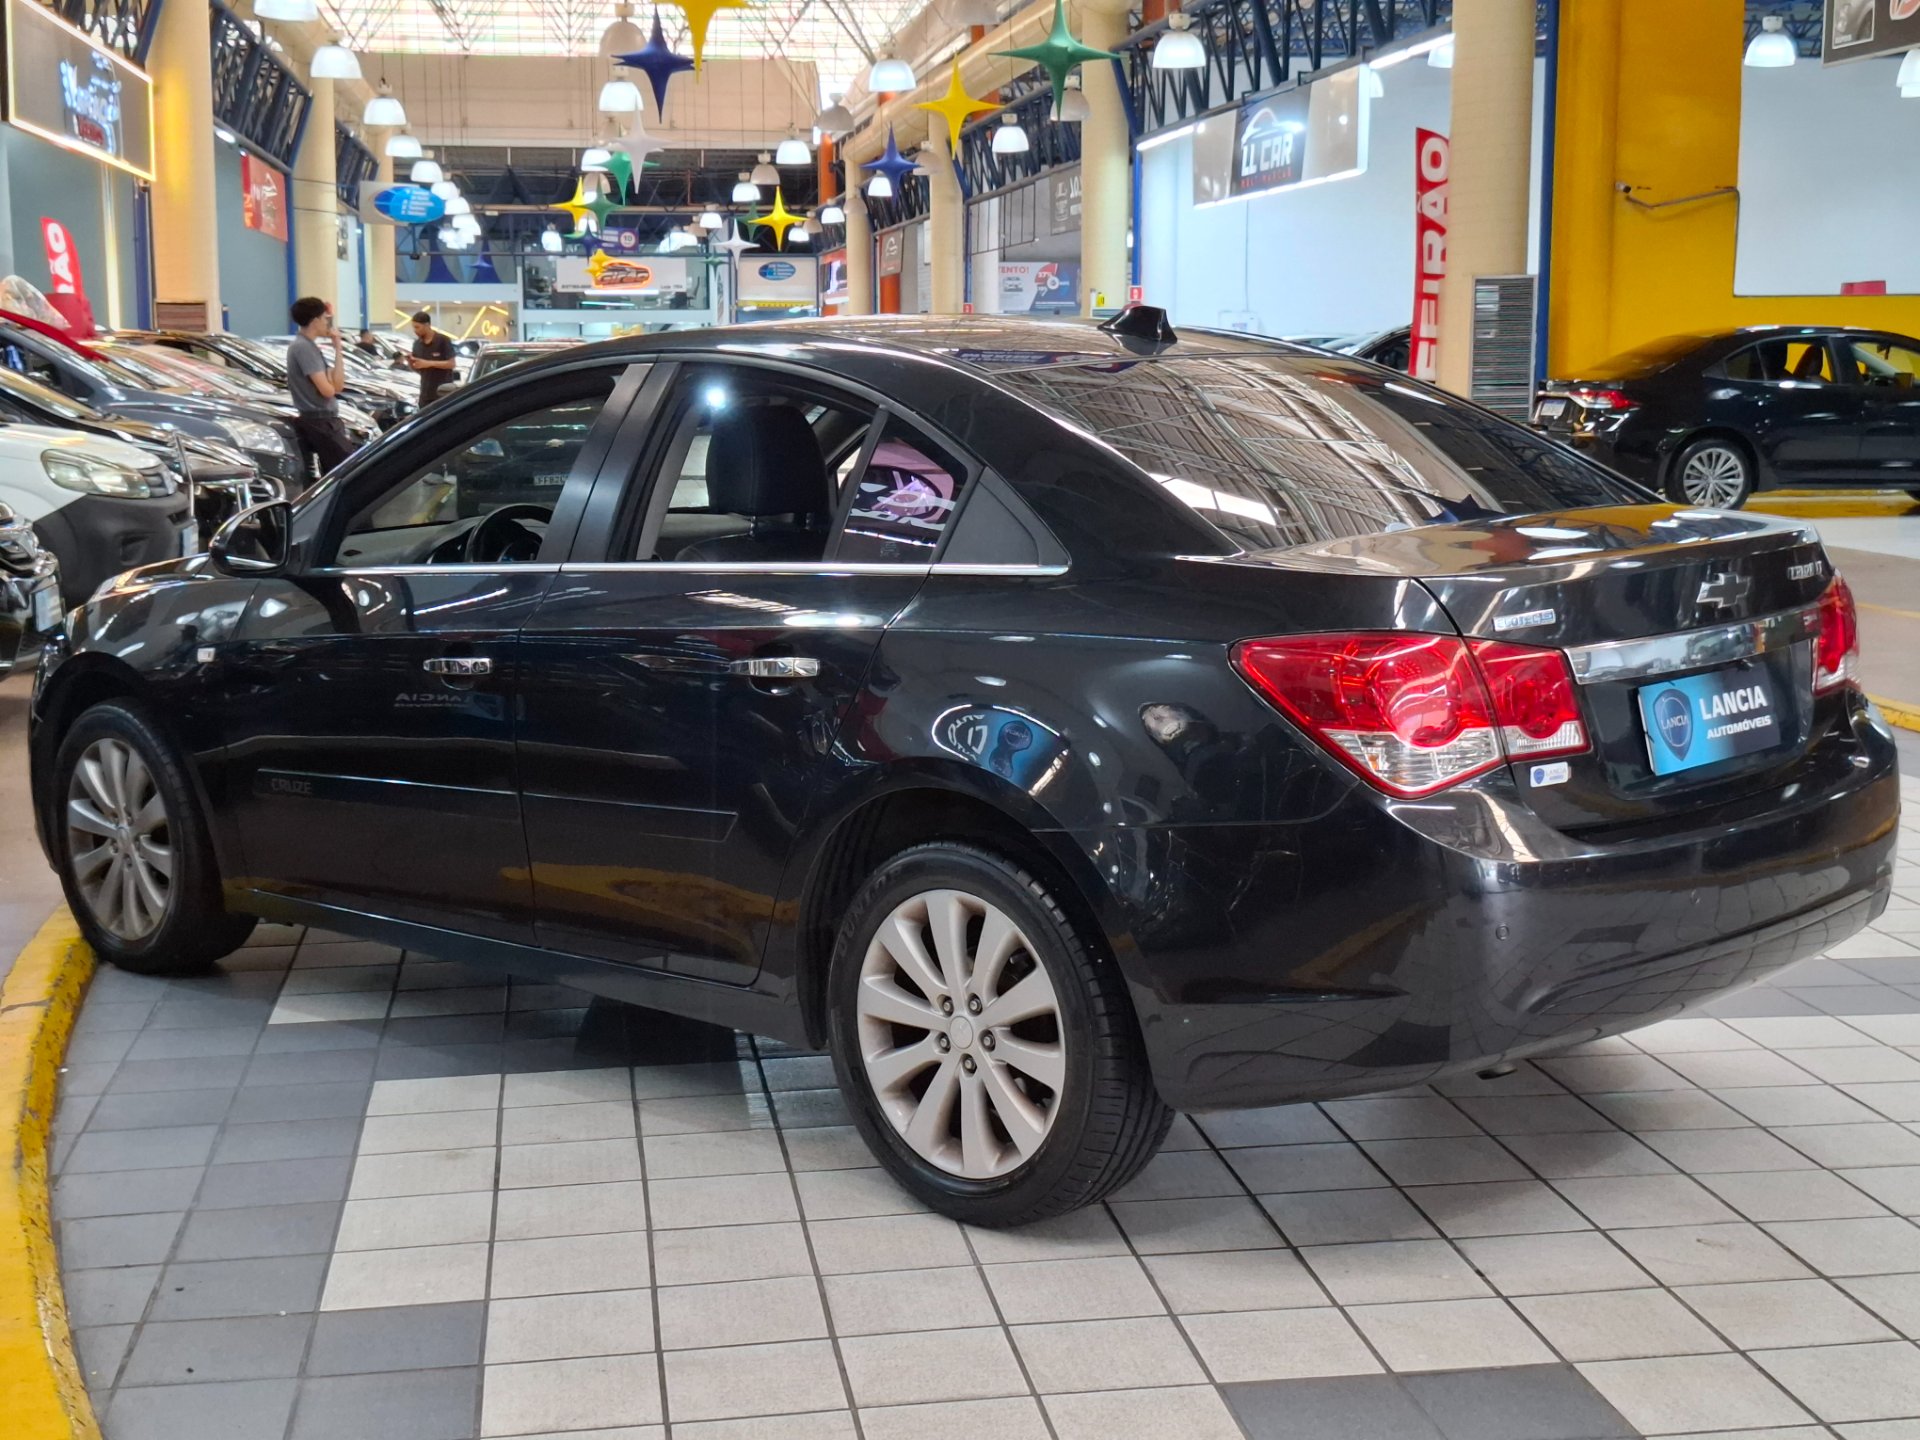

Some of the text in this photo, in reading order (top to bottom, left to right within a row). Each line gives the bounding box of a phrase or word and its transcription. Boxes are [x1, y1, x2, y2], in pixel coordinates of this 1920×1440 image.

[1260, 132, 1293, 171] CAR
[1416, 136, 1449, 382] FEIRÃO
[1699, 685, 1768, 721] LANCIA
[1660, 713, 1689, 731] LANCIA
[1706, 714, 1772, 740] AUTOMÓVEIS
[271, 778, 312, 795] CRUZE
